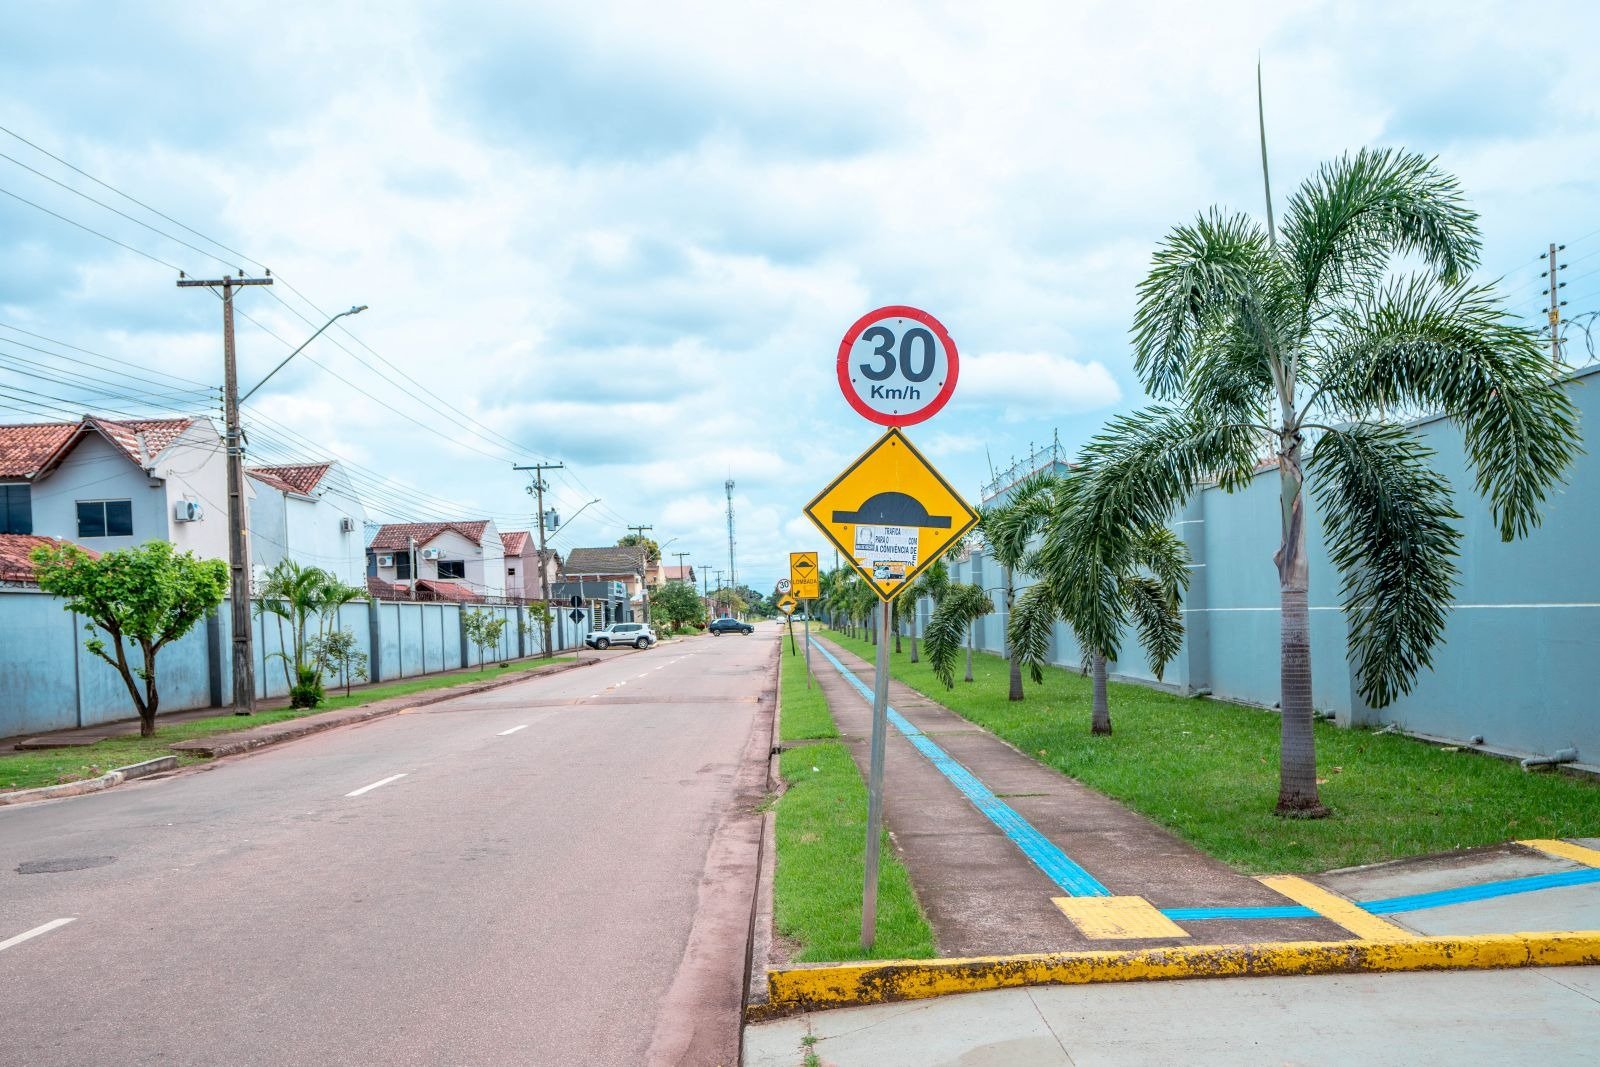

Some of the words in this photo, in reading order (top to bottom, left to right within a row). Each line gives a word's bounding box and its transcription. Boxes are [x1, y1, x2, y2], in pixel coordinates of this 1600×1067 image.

[860, 326, 936, 382] 30
[871, 385, 921, 400] Km/h
[780, 580, 789, 589] 30
